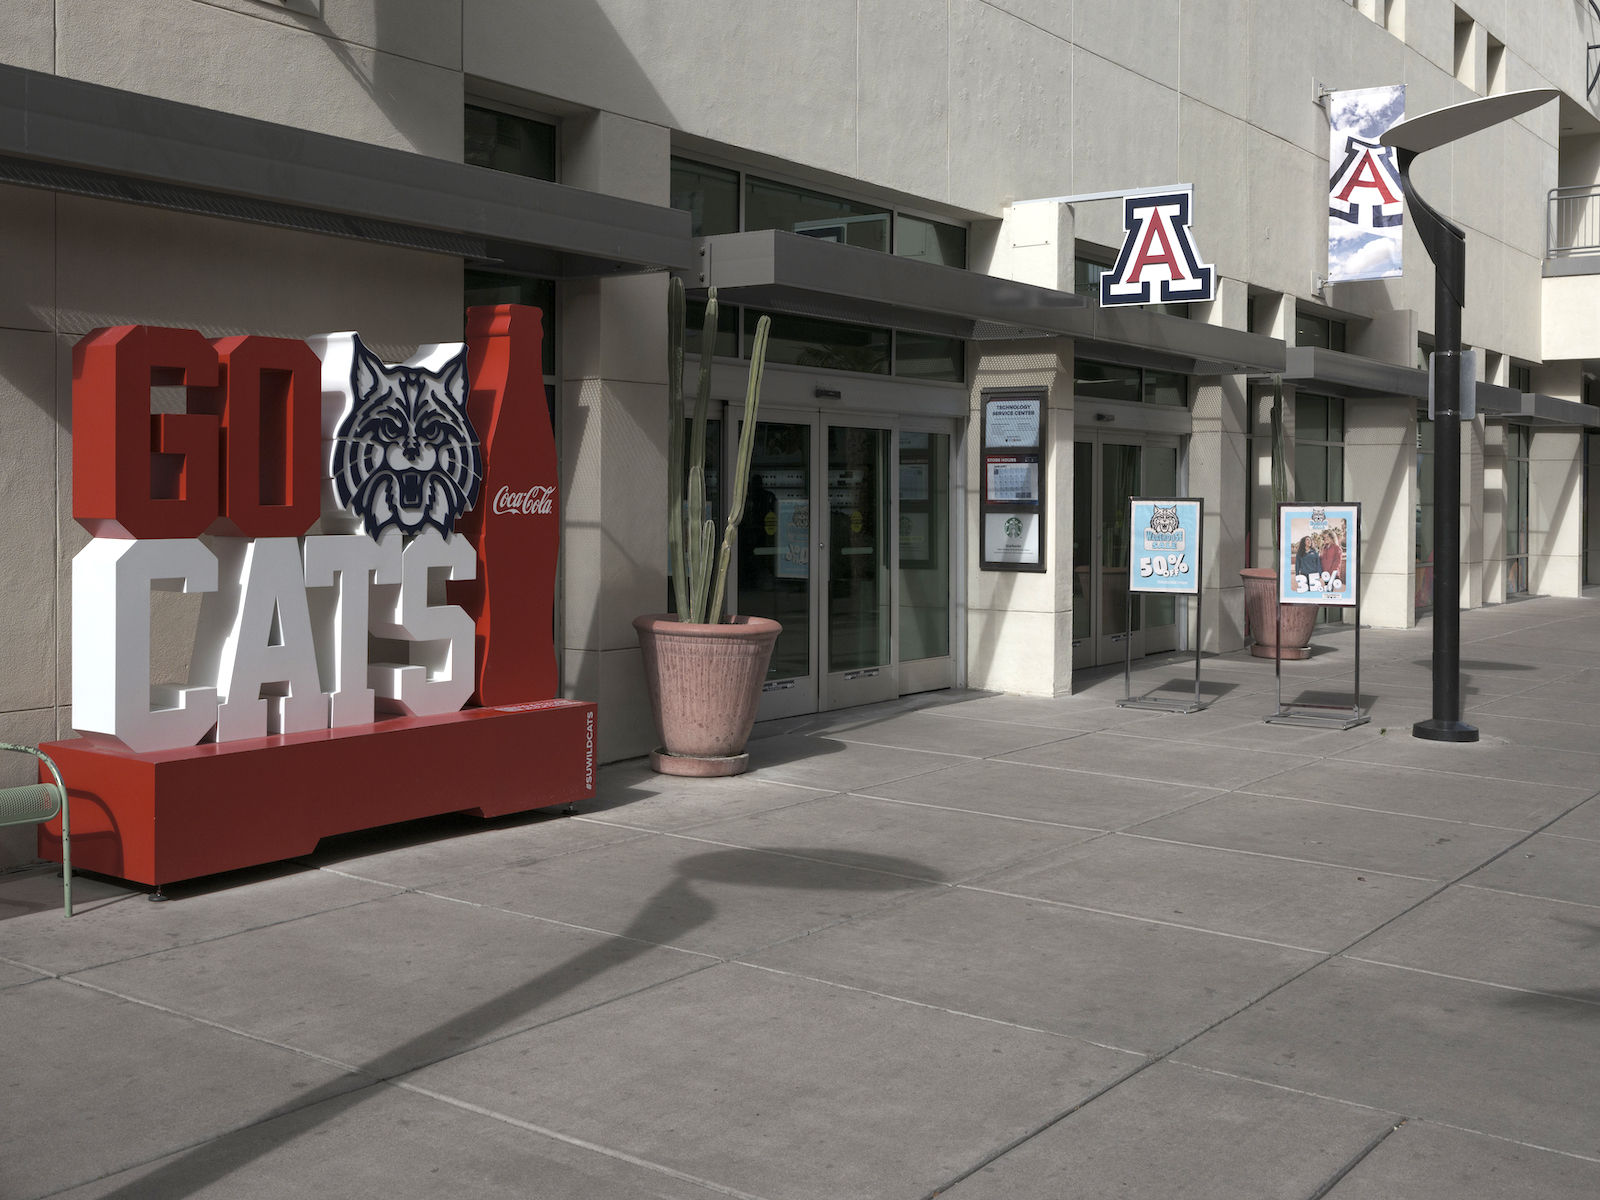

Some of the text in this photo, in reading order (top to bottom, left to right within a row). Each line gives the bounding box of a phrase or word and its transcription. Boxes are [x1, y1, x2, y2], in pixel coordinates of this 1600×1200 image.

[1330, 136, 1404, 229] A
[1101, 193, 1214, 307] A
[73, 325, 321, 540] GO
[492, 485, 557, 515] Coca-Cola
[1145, 530, 1184, 542] WAREHOUSE
[1152, 542, 1178, 550] SALE
[1140, 553, 1189, 578] 50%
[1163, 568, 1180, 578] OFF
[1295, 570, 1342, 594] 35%
[72, 532, 477, 754] CATS
[585, 711, 594, 790] #SUWILDCATS
